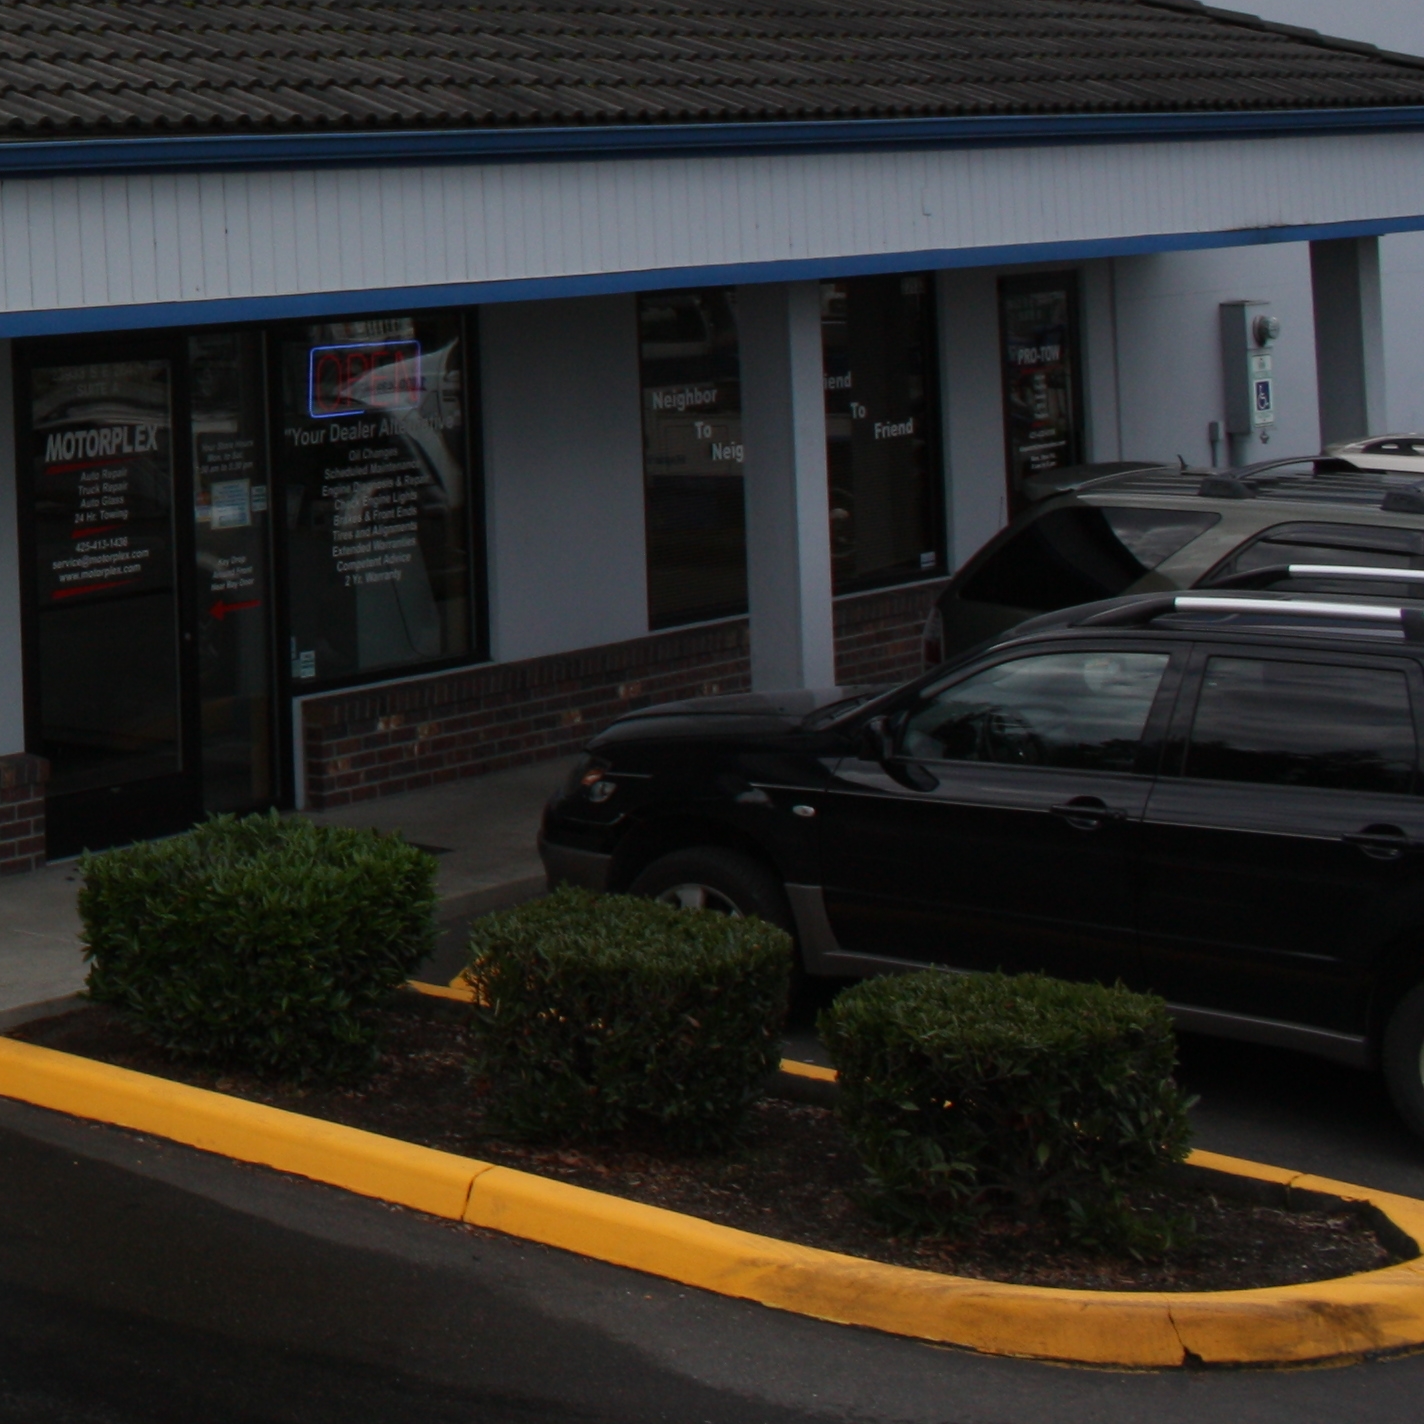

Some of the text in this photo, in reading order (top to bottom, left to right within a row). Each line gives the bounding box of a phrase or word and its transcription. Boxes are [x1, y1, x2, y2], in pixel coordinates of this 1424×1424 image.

[1017, 344, 1061, 365] PRO-TOW
[315, 351, 420, 412] OPEN
[653, 387, 718, 412] Neighbor
[850, 402, 867, 419] To
[284, 426, 326, 446] "Your
[330, 420, 377, 443] Dealer
[694, 420, 713, 439] To
[874, 417, 914, 440] Friend
[44, 424, 158, 463] MOTORPLEX
[348, 447, 399, 462] Oil Changes
[80, 468, 128, 482] Auto Repair
[324, 465, 369, 481] Scheduled
[78, 481, 128, 496] Truck Repair
[321, 483, 352, 499] Engine
[80, 495, 125, 509] Auto Glass
[362, 493, 392, 509] Engine
[392, 490, 418, 505] Lights
[99, 509, 129, 521] Towing
[364, 511, 371, 522] &
[371, 508, 396, 521] Front
[397, 506, 418, 518] Ends
[332, 521, 418, 542] Tires and Alignments
[52, 549, 150, 570] service@motorplex.com
[332, 542, 371, 558] Extended
[58, 563, 142, 582] www.motorplex.com
[336, 557, 382, 573] Competent
[344, 575, 352, 588] 2
[364, 568, 402, 583] Warranty
